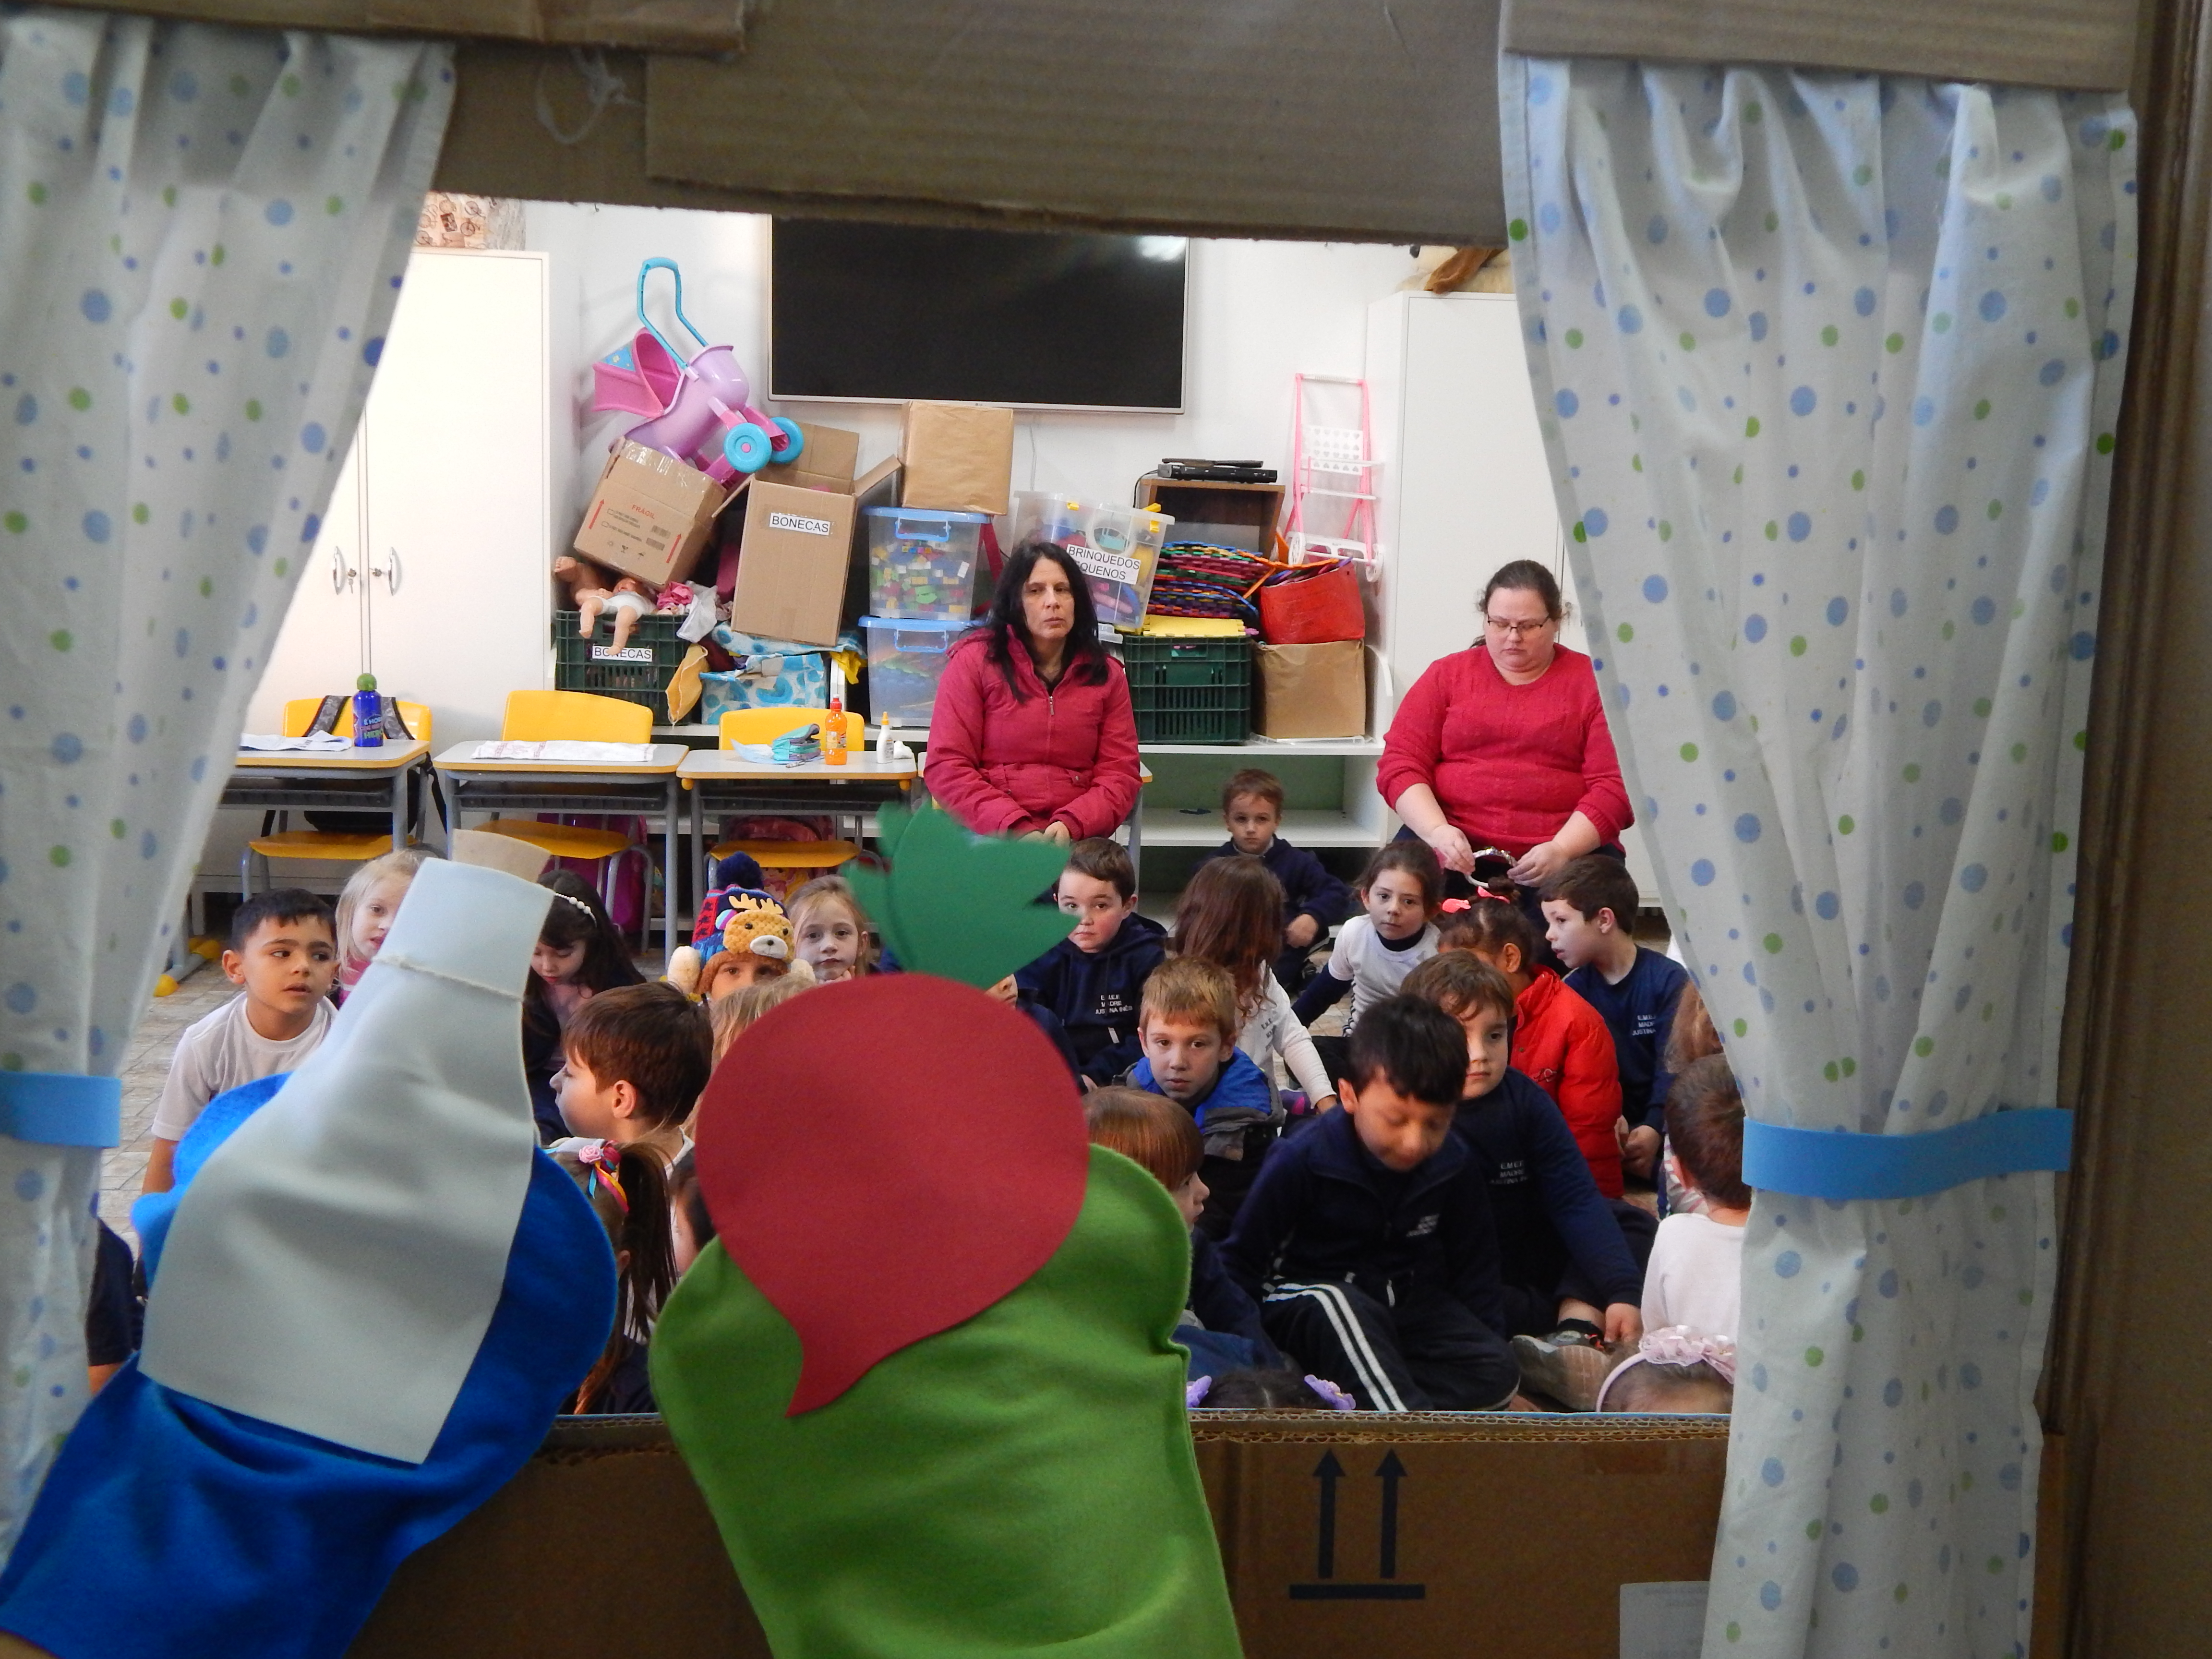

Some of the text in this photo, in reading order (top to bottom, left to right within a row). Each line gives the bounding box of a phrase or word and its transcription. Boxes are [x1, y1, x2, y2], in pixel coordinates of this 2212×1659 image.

[631, 505, 655, 519] FRÁGIL
[772, 516, 829, 532] BONECAS
[1069, 546, 1140, 570] BRINQUEDOS
[595, 647, 651, 659] BOECAS
